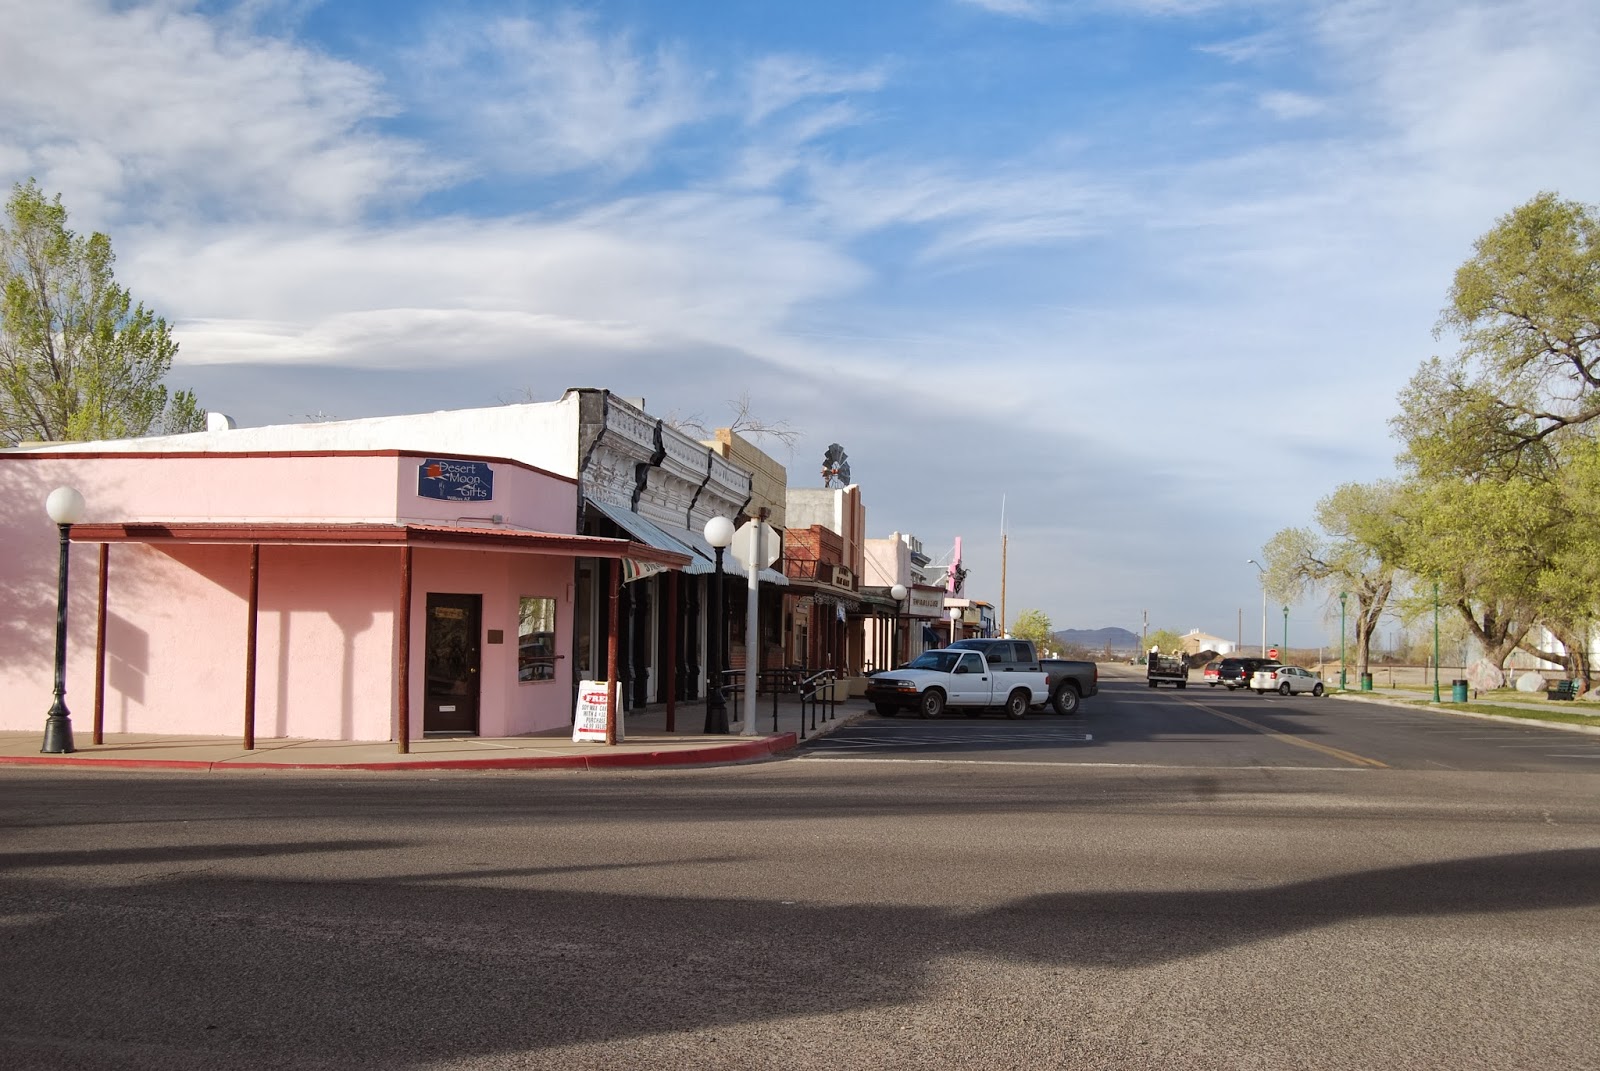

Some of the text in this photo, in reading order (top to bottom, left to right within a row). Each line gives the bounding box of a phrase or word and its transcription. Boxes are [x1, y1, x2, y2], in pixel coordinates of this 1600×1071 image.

[438, 461, 476, 474] Desert
[449, 473, 480, 484] Moon
[460, 483, 487, 497] Gifts
